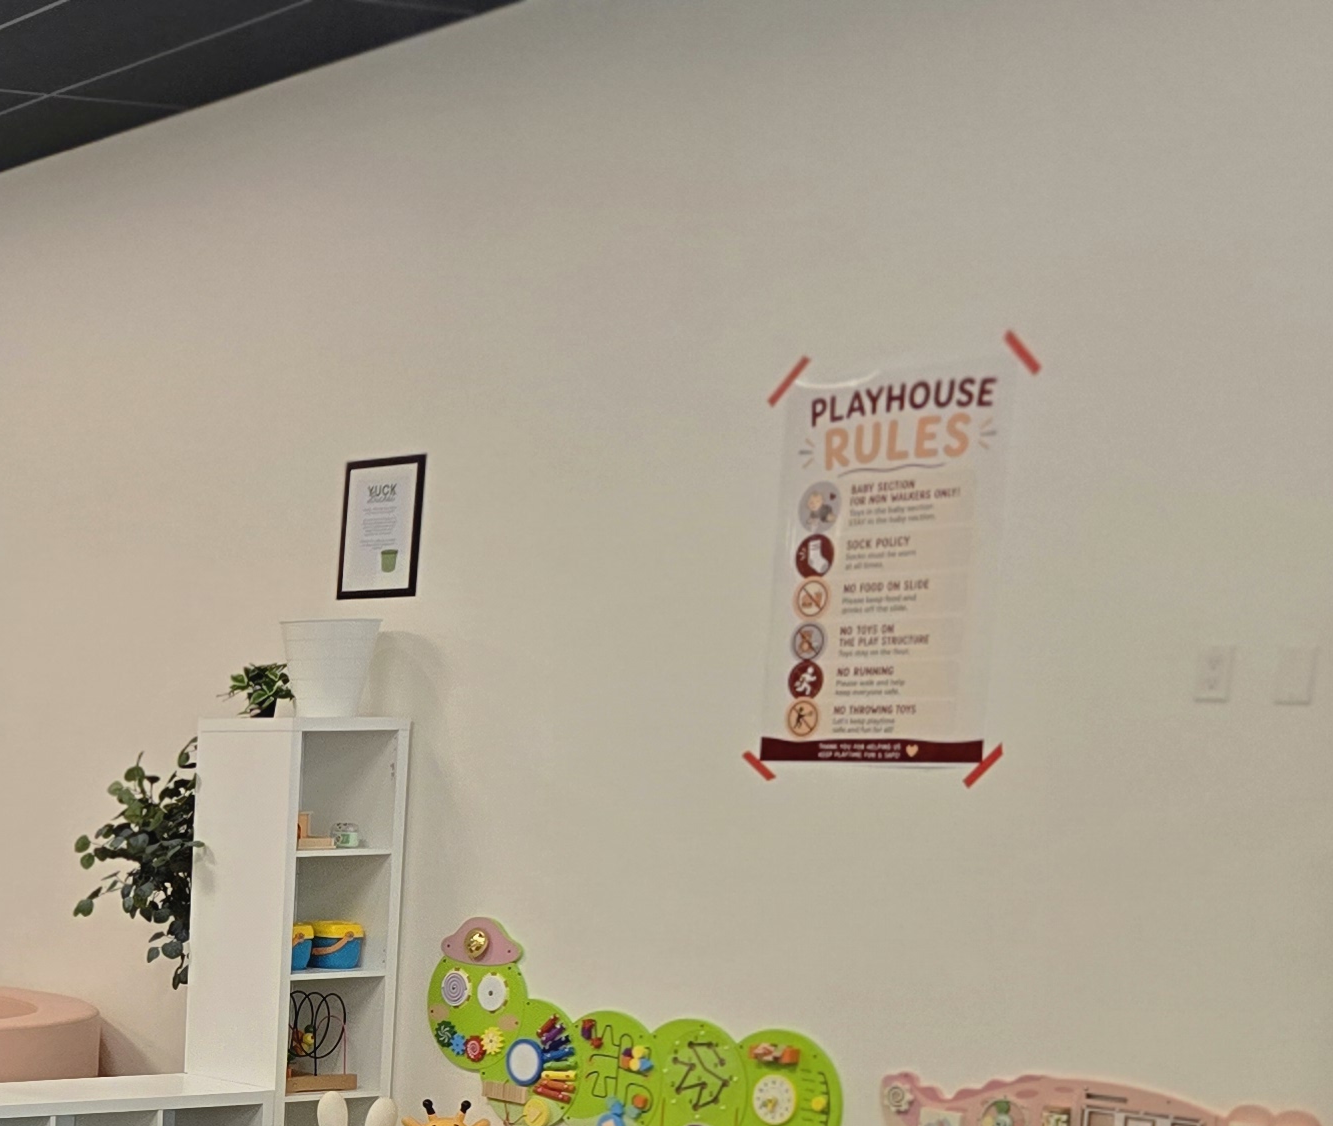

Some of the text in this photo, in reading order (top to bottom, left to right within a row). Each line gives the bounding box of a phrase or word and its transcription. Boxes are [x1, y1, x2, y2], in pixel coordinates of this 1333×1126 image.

[811, 376, 997, 427] PLAYHOUSE
[824, 412, 972, 471] RULES
[851, 480, 915, 495] BABY SECTION
[849, 487, 961, 506] FOR NON WALKERS ONLY!
[846, 535, 911, 551] SOCK POLICY
[843, 578, 929, 593] NO FOOD ON SLIDE
[840, 623, 895, 636] NO TOYS ON
[839, 633, 930, 647] THE PLAY STRUCTURE
[836, 665, 895, 677] NO RUNNING
[833, 704, 917, 715] NO THROWING TOYS
